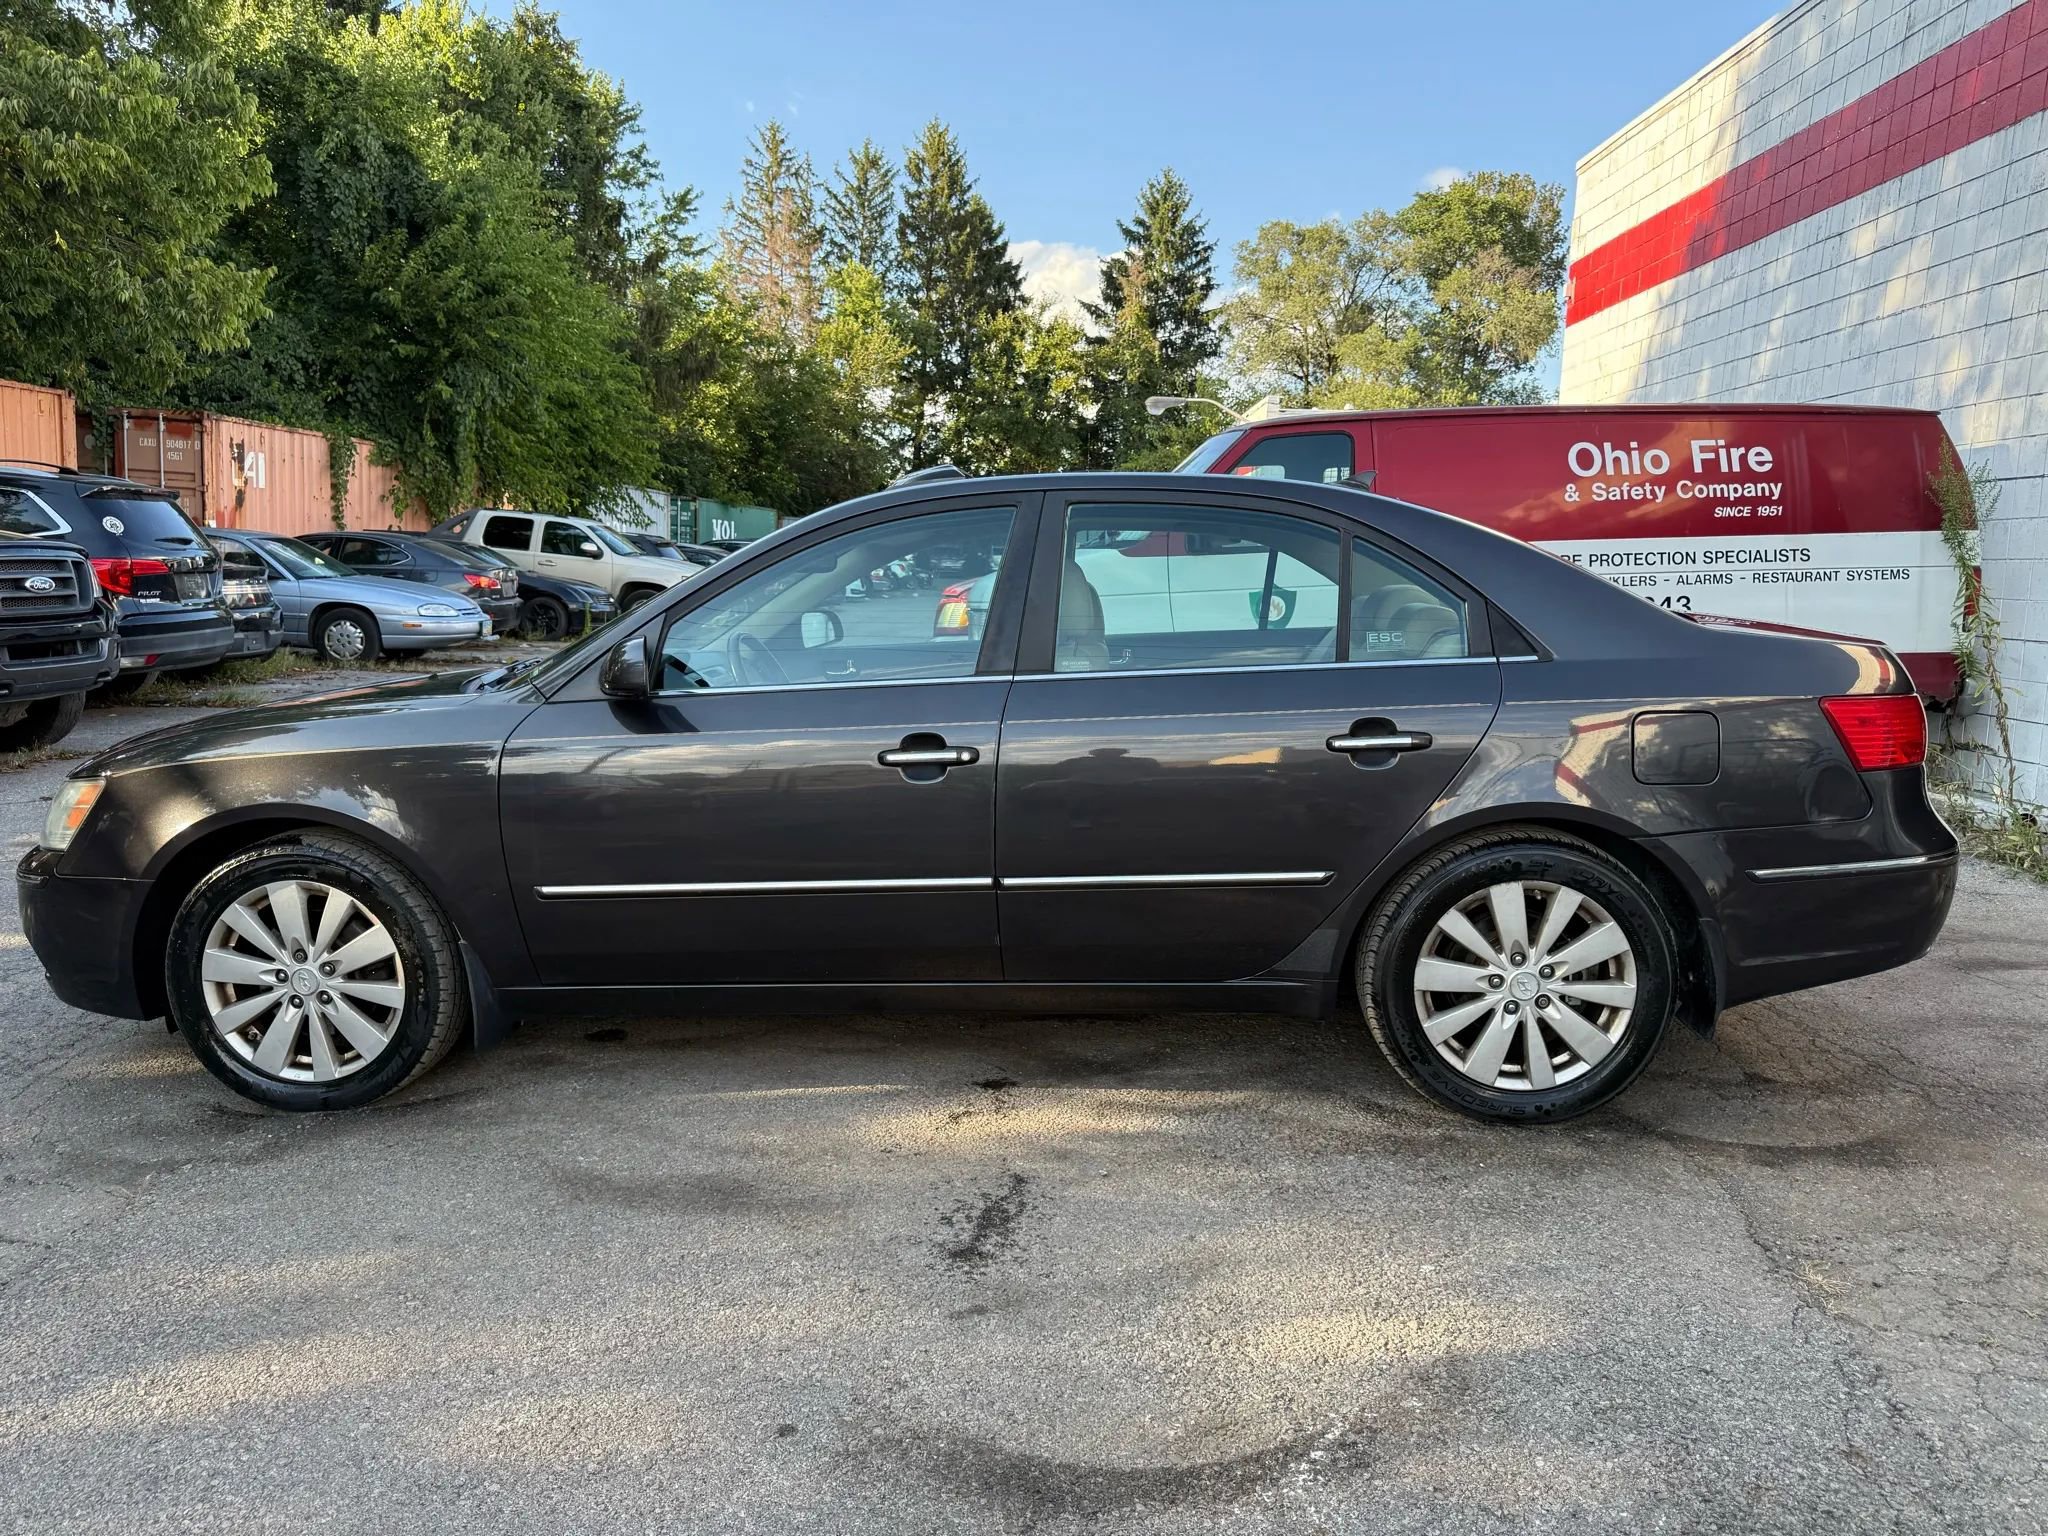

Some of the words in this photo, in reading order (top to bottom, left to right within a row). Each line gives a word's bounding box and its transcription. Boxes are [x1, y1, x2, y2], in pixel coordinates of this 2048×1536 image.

[139, 438, 157, 447] CAXU
[1567, 441, 1670, 478] Ohio
[1690, 439, 1773, 473] Fire
[1564, 483, 1580, 502] &
[1591, 482, 1666, 503] Safety
[1676, 480, 1782, 501] Company
[1713, 506, 1751, 518] SINCE
[1756, 505, 1783, 517] 1951
[1588, 551, 1697, 567] PROTECTION
[1703, 548, 1811, 565] SPECIALISTS
[1609, 575, 1657, 587] KLERS
[1676, 573, 1733, 586] ALARMS
[1752, 570, 1841, 584] RESTAURANT
[1846, 568, 1910, 582] SYSTEMS
[1645, 595, 1692, 611] 43
[1368, 632, 1403, 643] ESC
